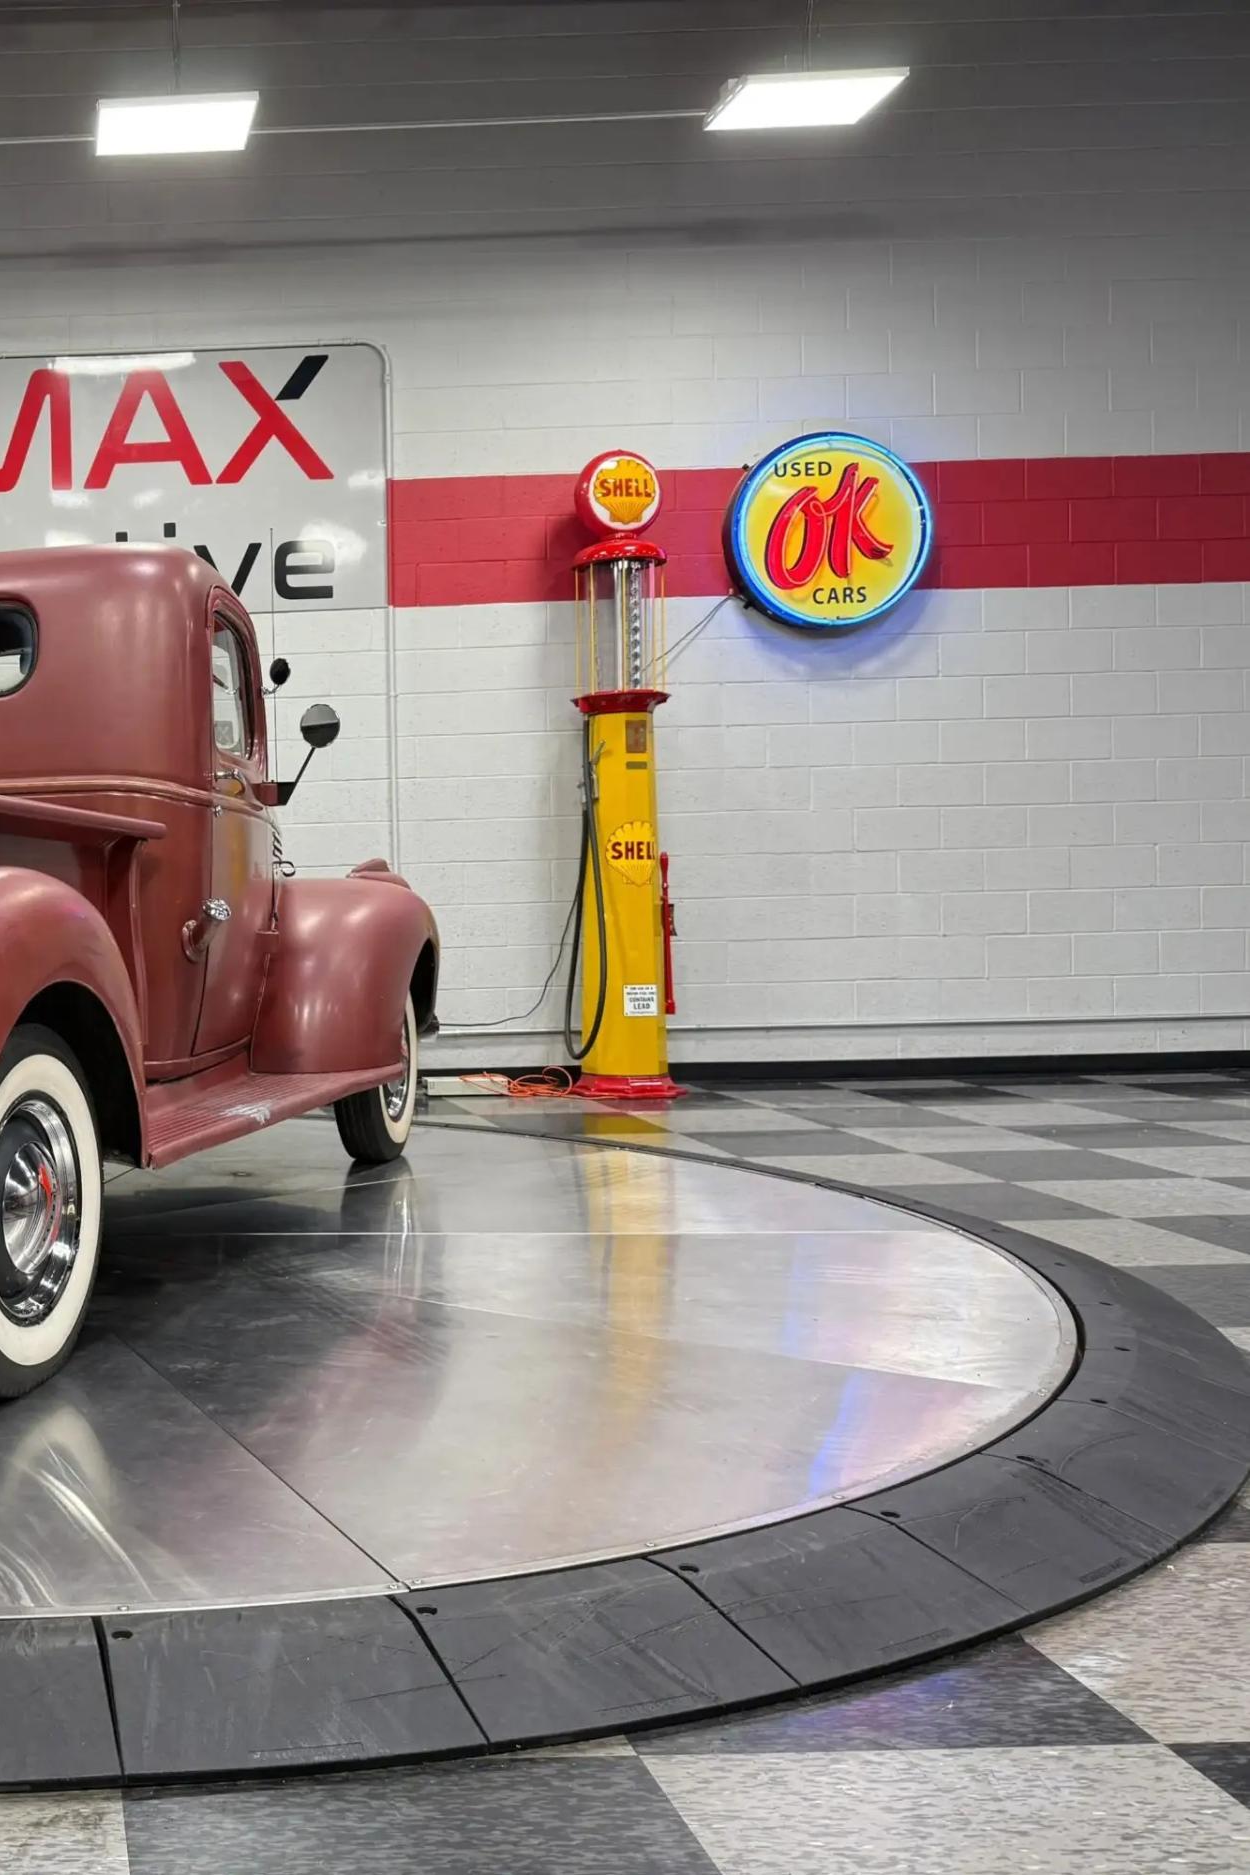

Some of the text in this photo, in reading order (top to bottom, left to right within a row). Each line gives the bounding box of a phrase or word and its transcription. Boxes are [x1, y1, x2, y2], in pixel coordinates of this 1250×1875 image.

[774, 461, 832, 478] USED
[599, 478, 652, 497] SHELL
[764, 463, 894, 590] OK
[812, 586, 867, 605] CARS
